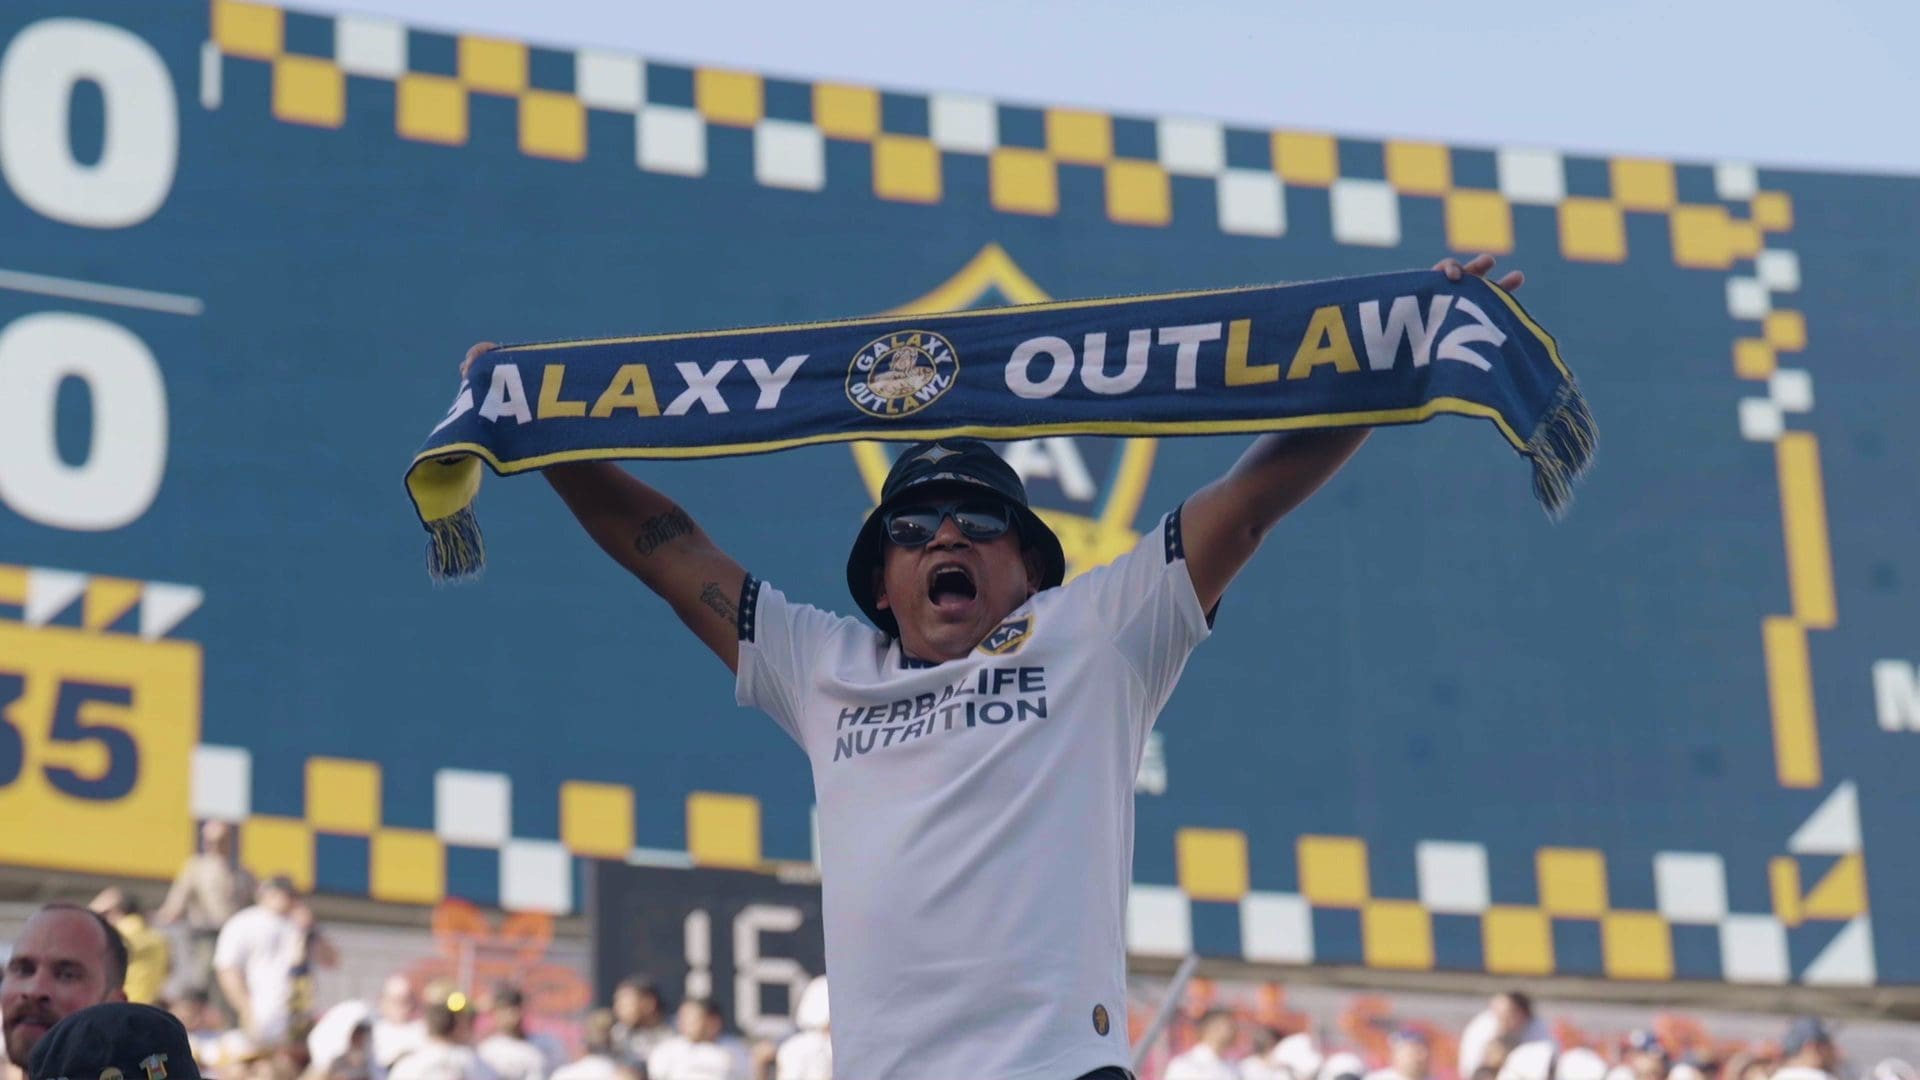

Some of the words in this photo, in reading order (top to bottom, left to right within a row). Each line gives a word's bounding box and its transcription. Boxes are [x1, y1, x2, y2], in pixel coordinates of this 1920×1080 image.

[0, 17, 180, 229] 0
[856, 333, 953, 372] GALAXY
[1004, 294, 1507, 399] OUTLAWZ
[0, 311, 169, 531] 0
[850, 373, 951, 414] OUTLAWZ
[990, 627, 1024, 649] LA
[833, 696, 1048, 762] NUTRITION
[836, 666, 1046, 731] HERBALIFE
[0, 671, 140, 804] 5
